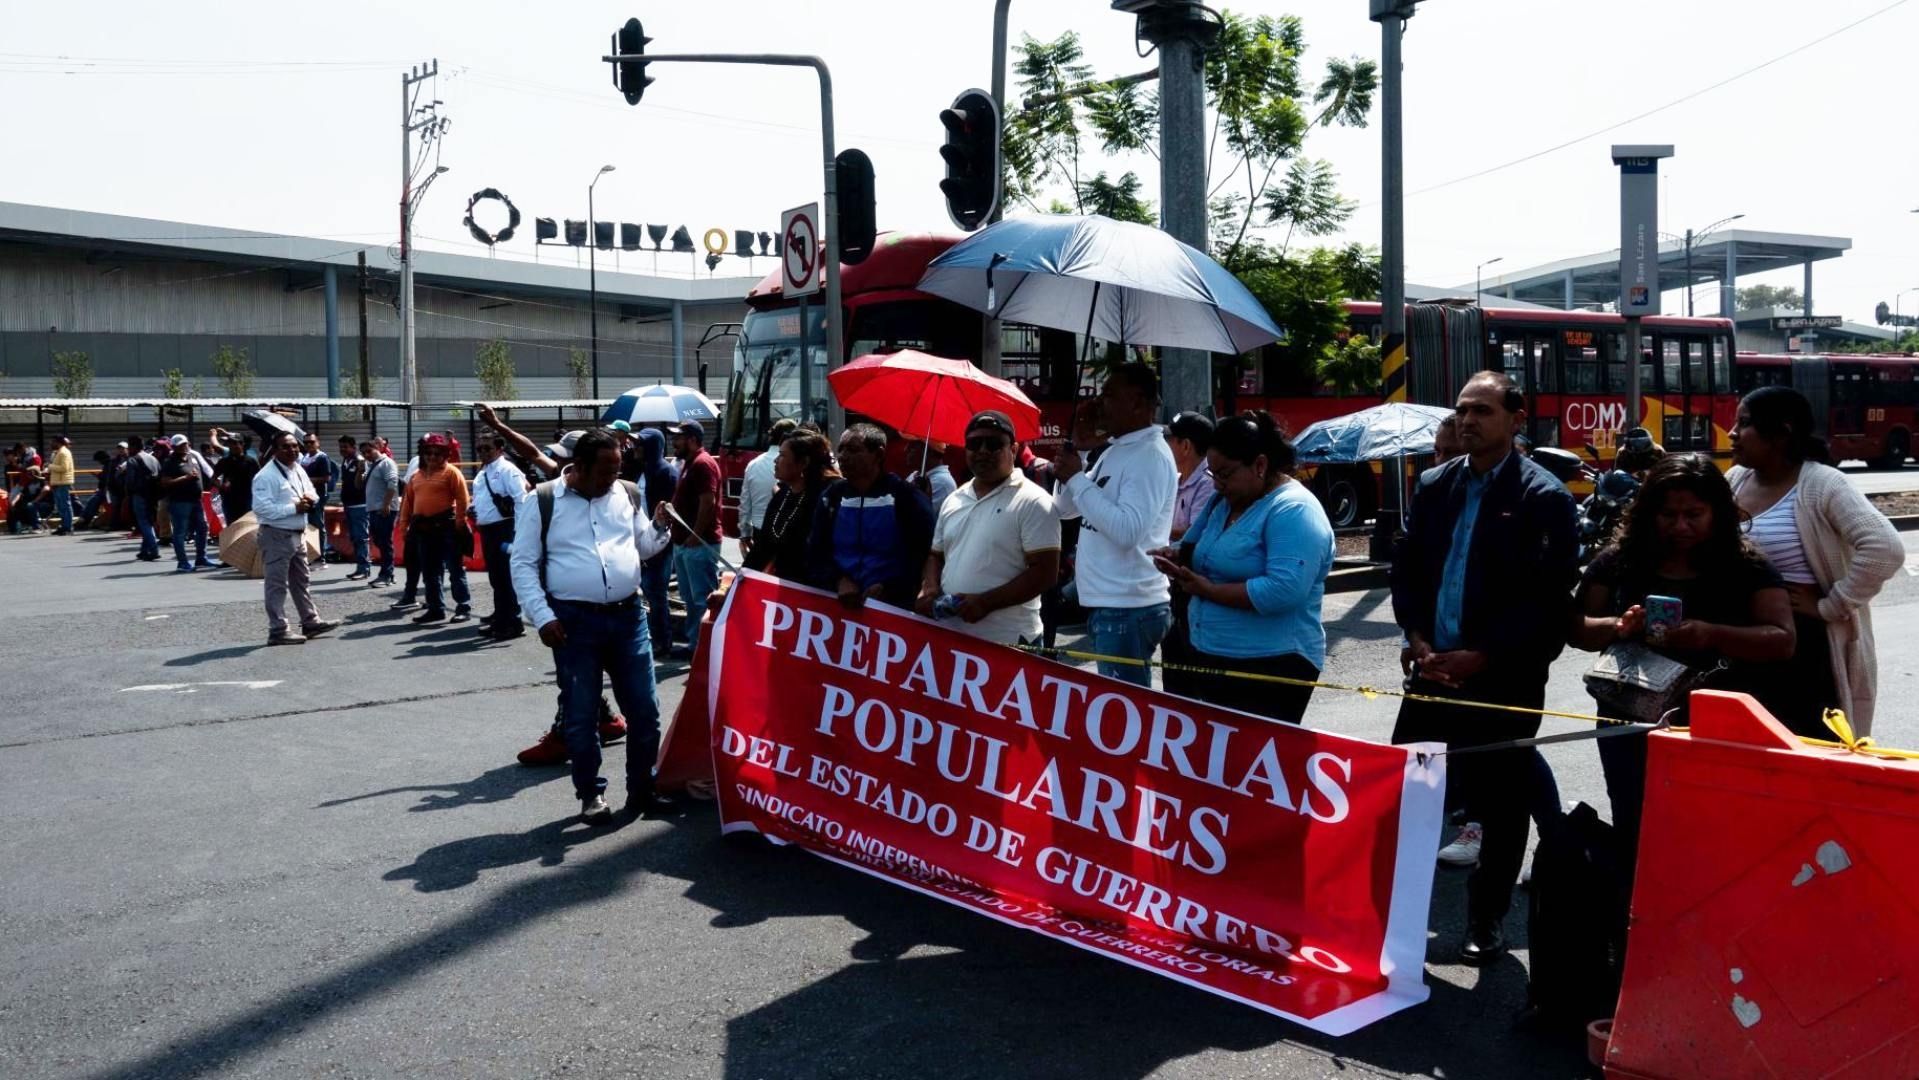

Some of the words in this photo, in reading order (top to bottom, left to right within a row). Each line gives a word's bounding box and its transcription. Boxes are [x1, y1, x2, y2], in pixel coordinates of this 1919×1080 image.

[1566, 402, 1628, 432] CDMX
[755, 599, 1352, 824] PREPARATORIAS
[736, 783, 844, 841] SINDICATO
[815, 683, 1229, 875] POPULARES
[722, 725, 802, 778] DEL
[806, 755, 957, 837] ESTADO
[964, 815, 1025, 867] DE
[1035, 846, 1352, 974] GUERRERO
[1058, 920, 1208, 974] GUERRERO
